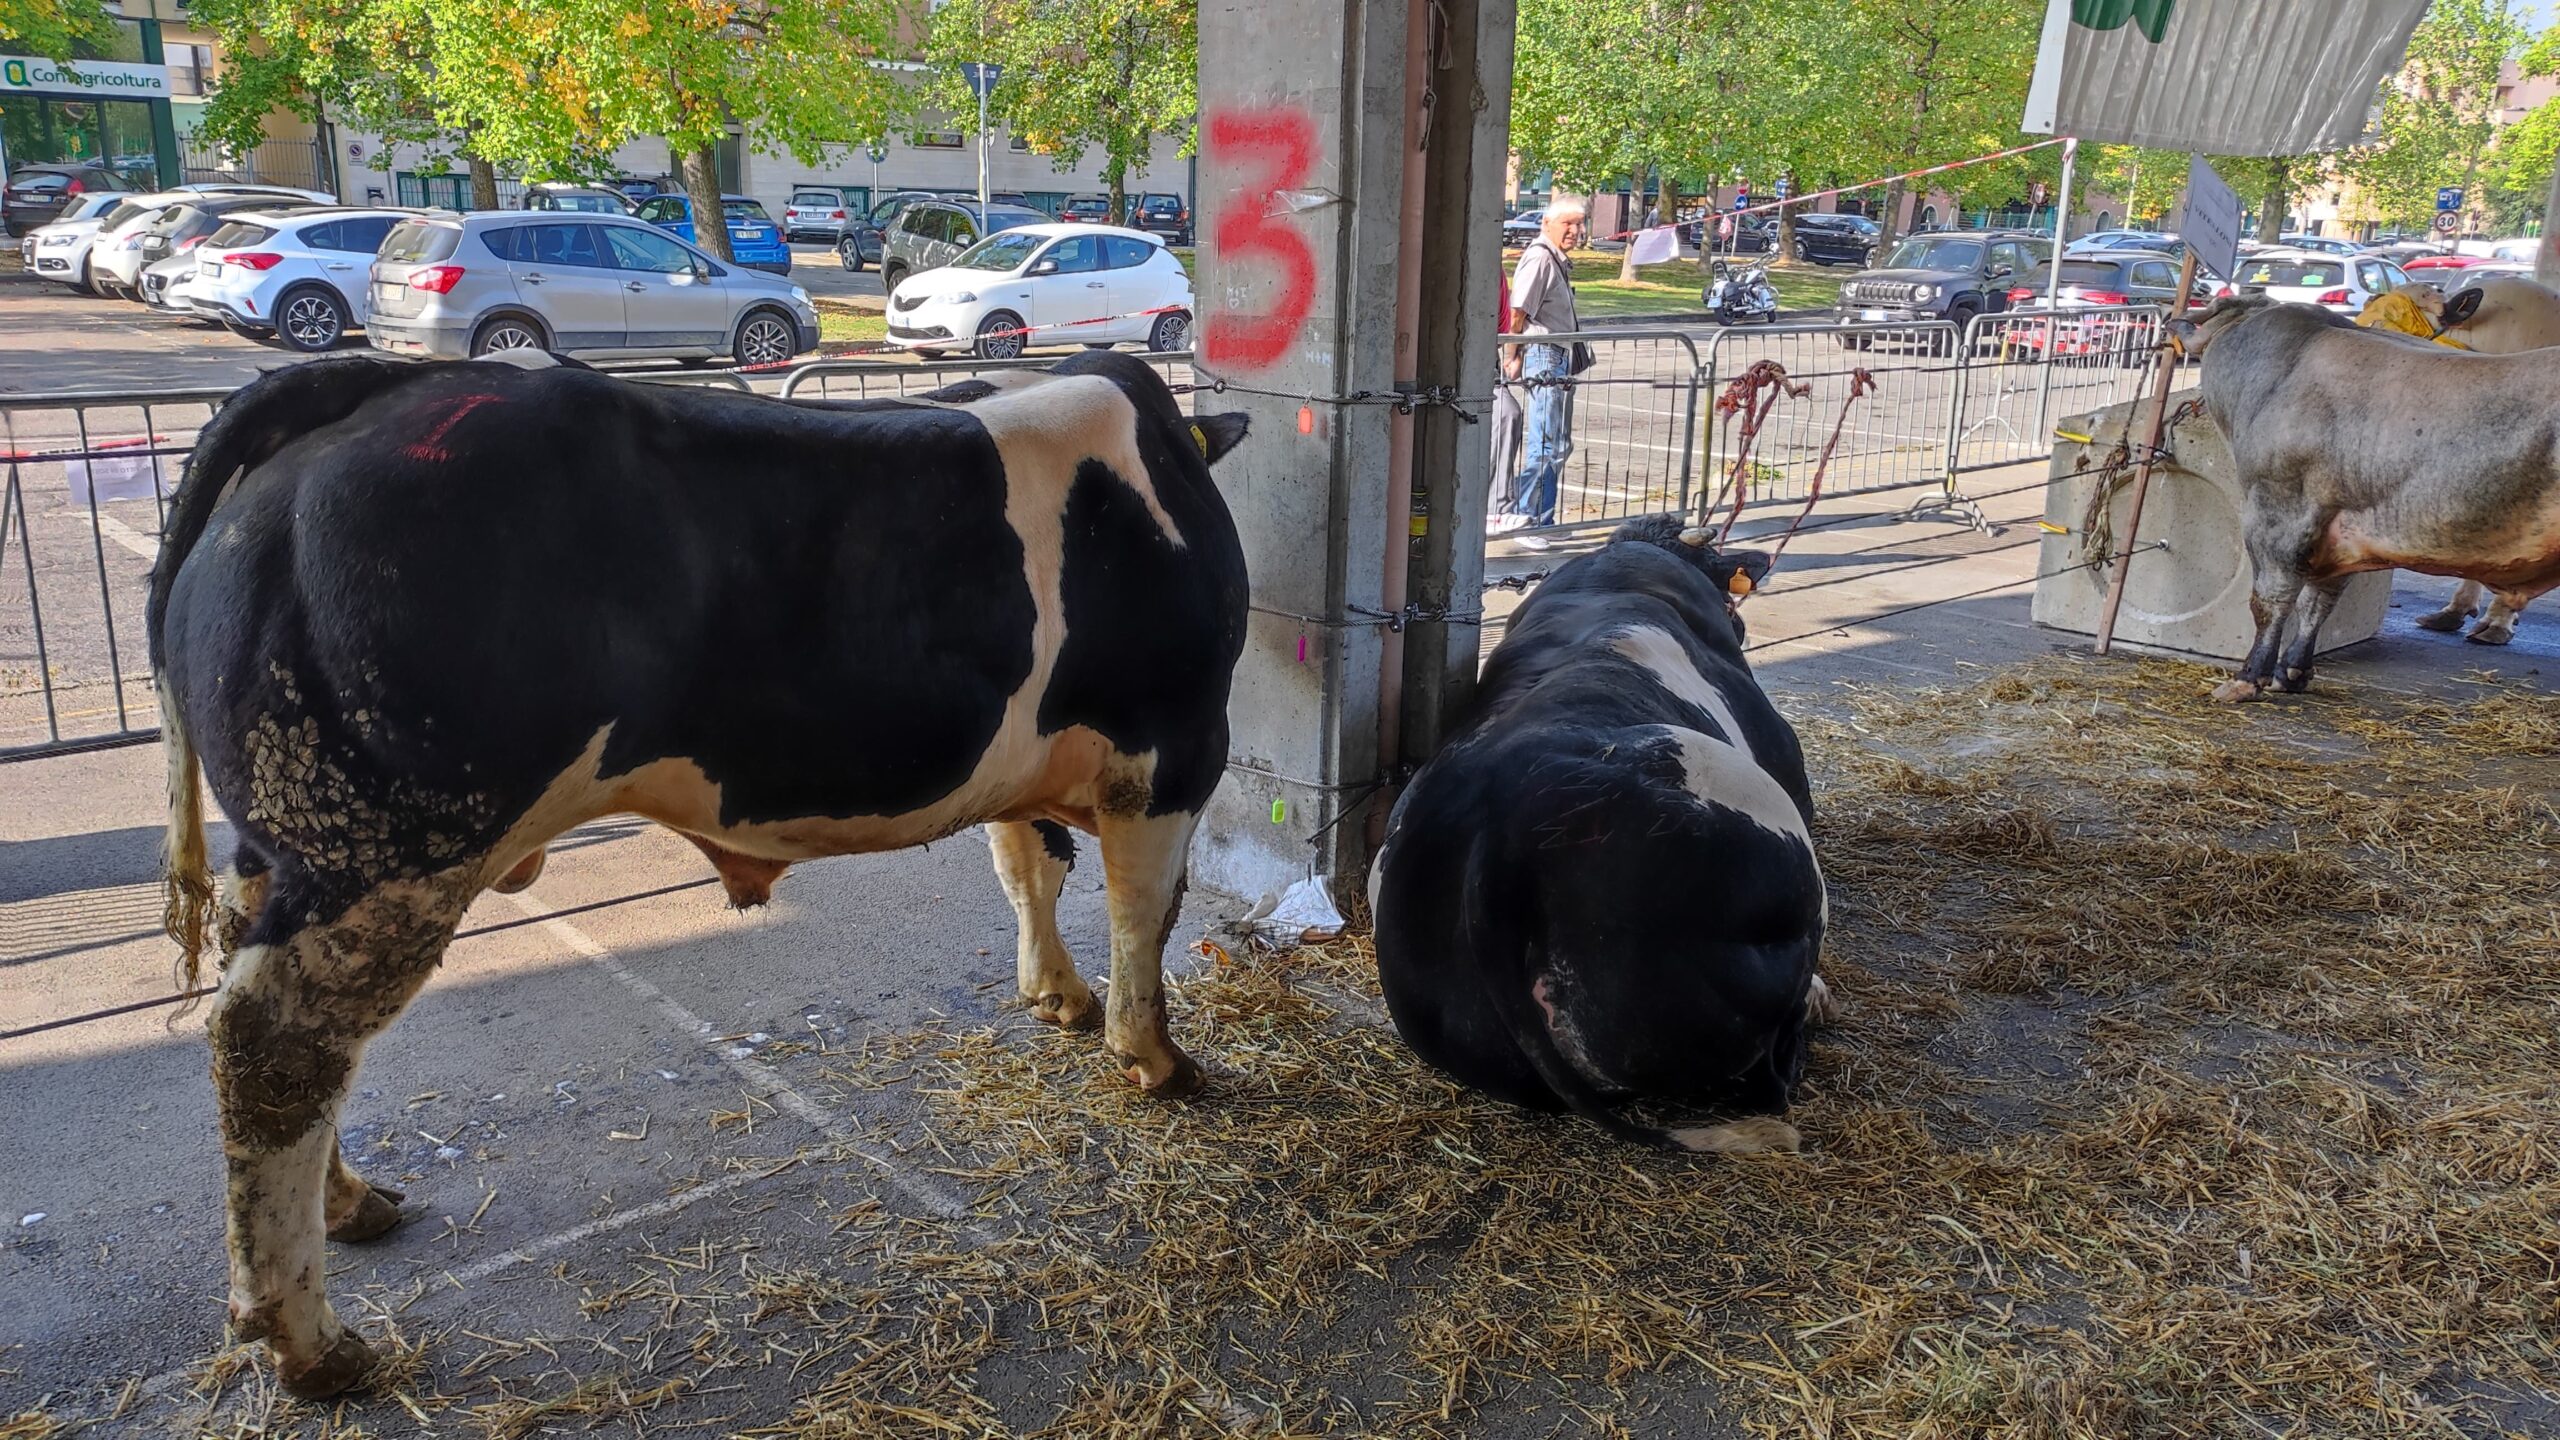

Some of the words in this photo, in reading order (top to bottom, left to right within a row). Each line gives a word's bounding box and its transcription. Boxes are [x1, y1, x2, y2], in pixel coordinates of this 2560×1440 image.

[32, 67, 161, 88] Conagricoltura
[2439, 216, 2454, 227] 30
[1205, 112, 1316, 368] 3
